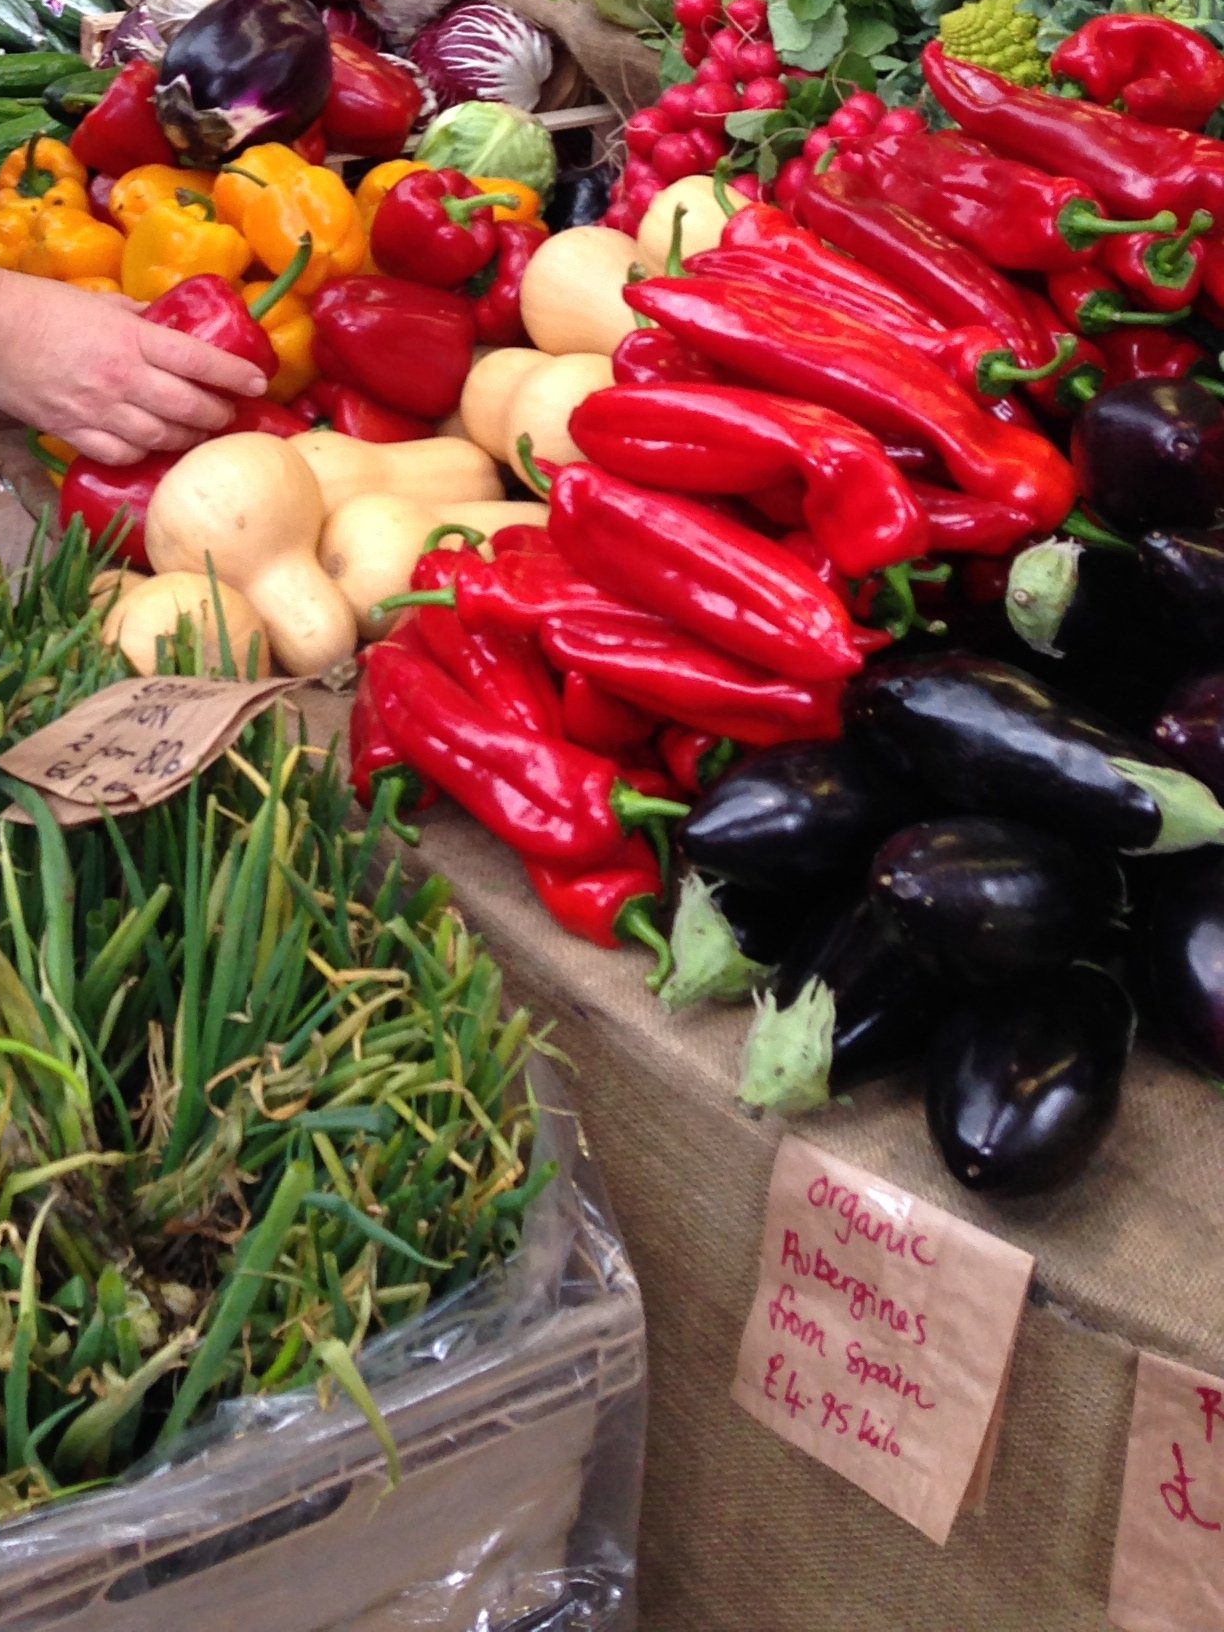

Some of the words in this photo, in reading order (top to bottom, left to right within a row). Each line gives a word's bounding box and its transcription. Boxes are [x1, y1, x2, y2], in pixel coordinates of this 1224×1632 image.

[66, 733, 94, 752] 2
[134, 739, 185, 778] 80p
[769, 1284, 826, 1357] from
[782, 1229, 927, 1345] Aubergines
[764, 1353, 852, 1435] £4.95
[857, 1409, 901, 1457] kilo
